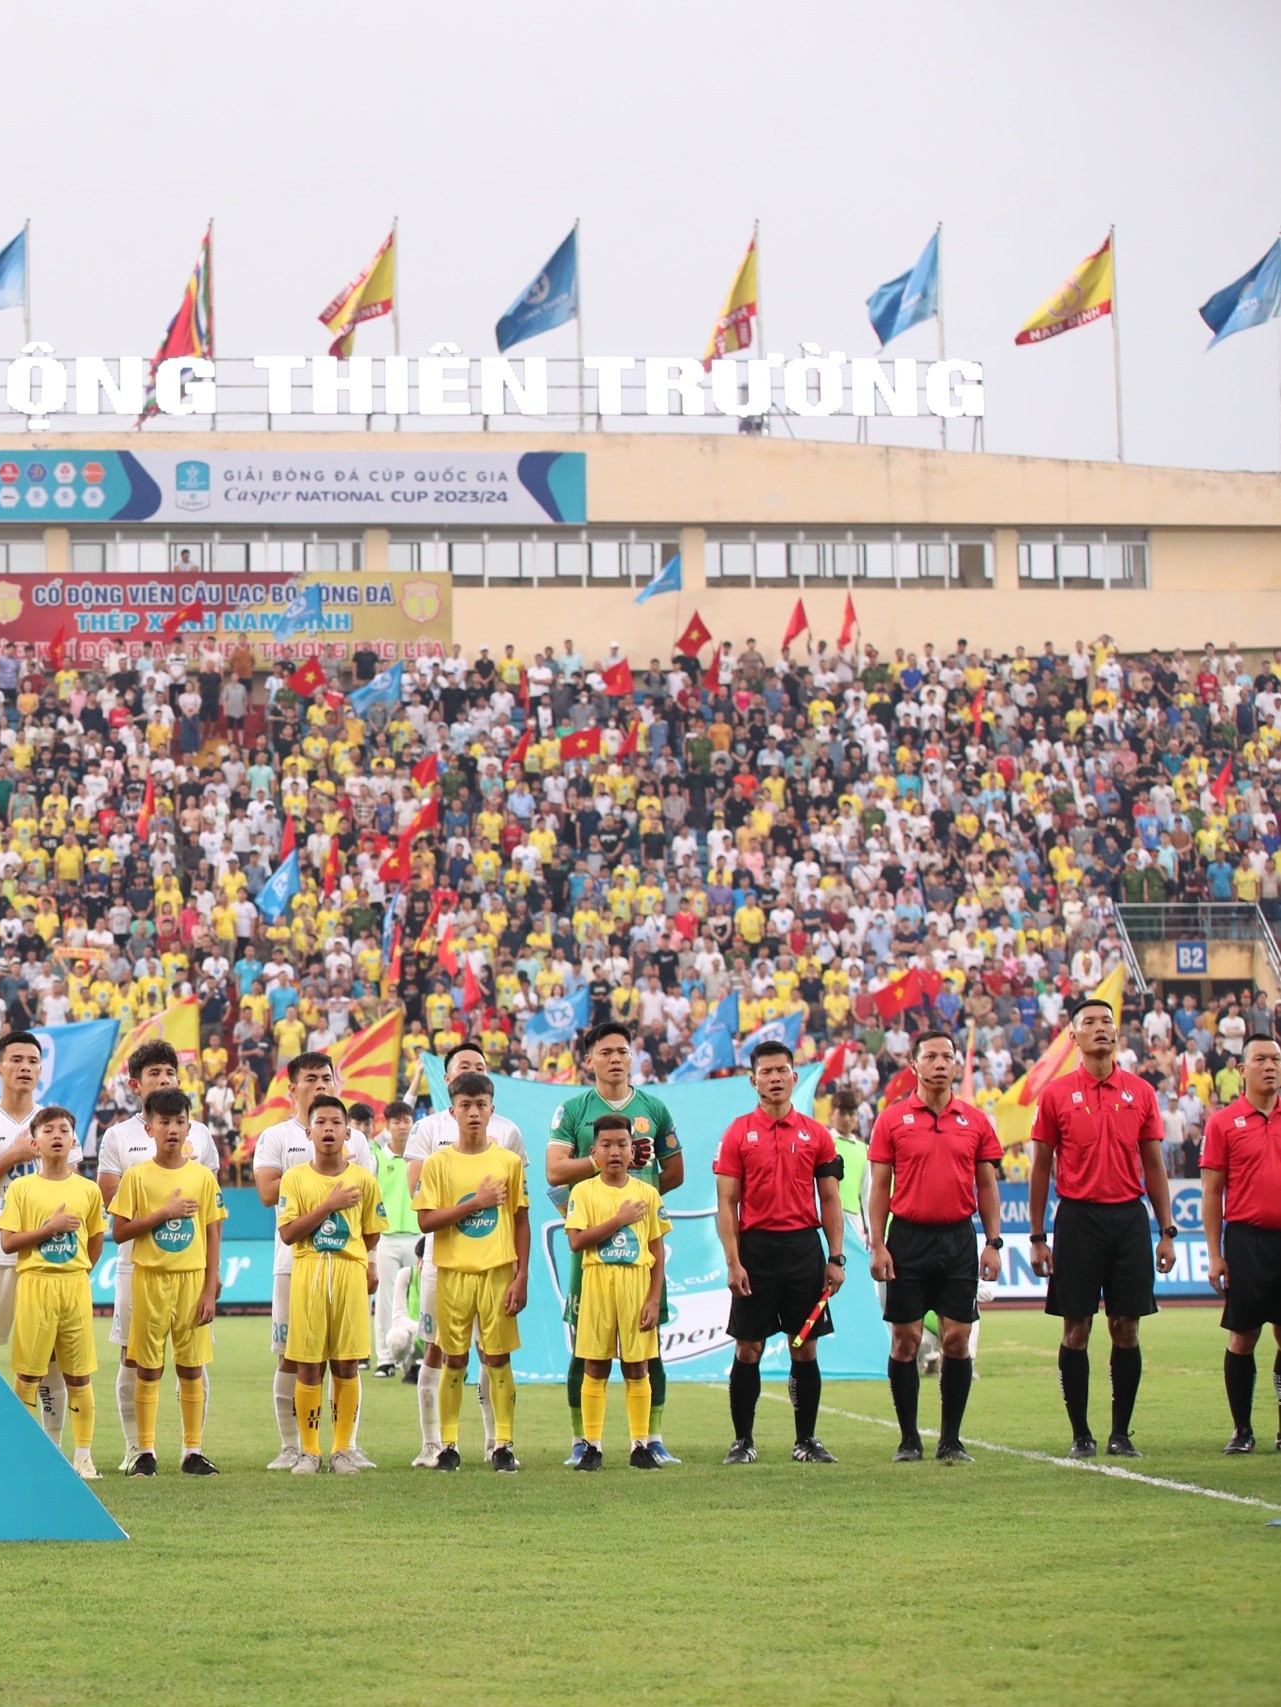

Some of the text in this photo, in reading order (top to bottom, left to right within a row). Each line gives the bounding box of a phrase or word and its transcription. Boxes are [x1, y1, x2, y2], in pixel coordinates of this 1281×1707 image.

[253, 342, 548, 415] THIÊN
[584, 342, 986, 417] TRƯỜNG
[223, 465, 508, 483] GIẢI BÓNG ĐÁ CÚP QUỐC GIA
[223, 487, 509, 505] Casper NATIONAL CUP 2023/24
[67, 581, 123, 609] ĐỘNG
[129, 581, 175, 605] VIÊN
[181, 580, 221, 605] CÂU
[227, 584, 266, 610] LẠC
[306, 582, 359, 604] ÓNG
[76, 607, 140, 633] THÉP
[147, 611, 216, 633] XNH
[224, 611, 283, 632] NAM
[1178, 947, 1204, 969] B2
[154, 1231, 192, 1243] Casper
[599, 1247, 638, 1260] Casper
[39, 1385, 54, 1413] mitre
